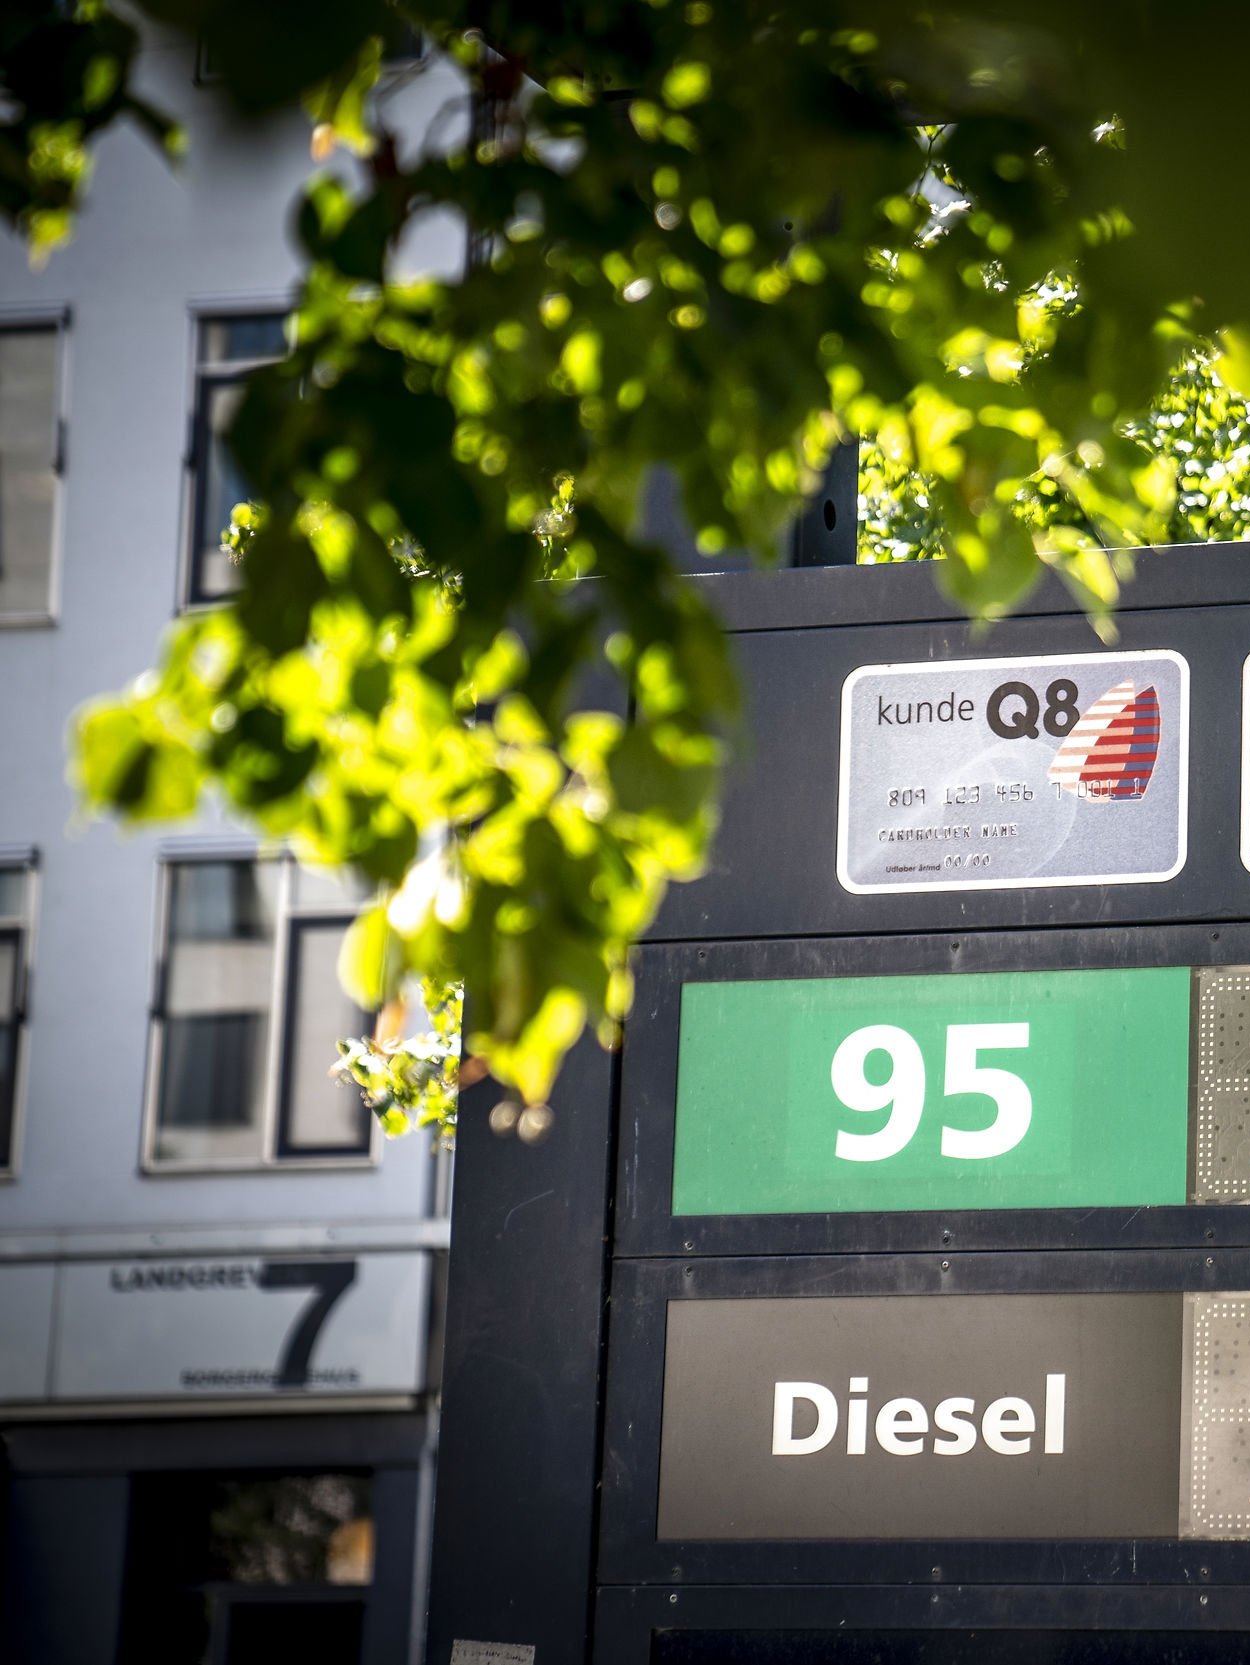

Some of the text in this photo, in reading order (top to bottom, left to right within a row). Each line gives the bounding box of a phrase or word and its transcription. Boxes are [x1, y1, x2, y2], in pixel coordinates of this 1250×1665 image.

[878, 678, 1080, 740] kunde Q8
[888, 787, 926, 807] 809
[943, 784, 980, 805] 123
[996, 783, 1034, 802] 456
[879, 824, 1018, 842] CARDHOLDER NAME
[829, 1021, 1033, 1162] 95
[257, 1261, 359, 1390] 7
[771, 1373, 1066, 1457] Diesel
